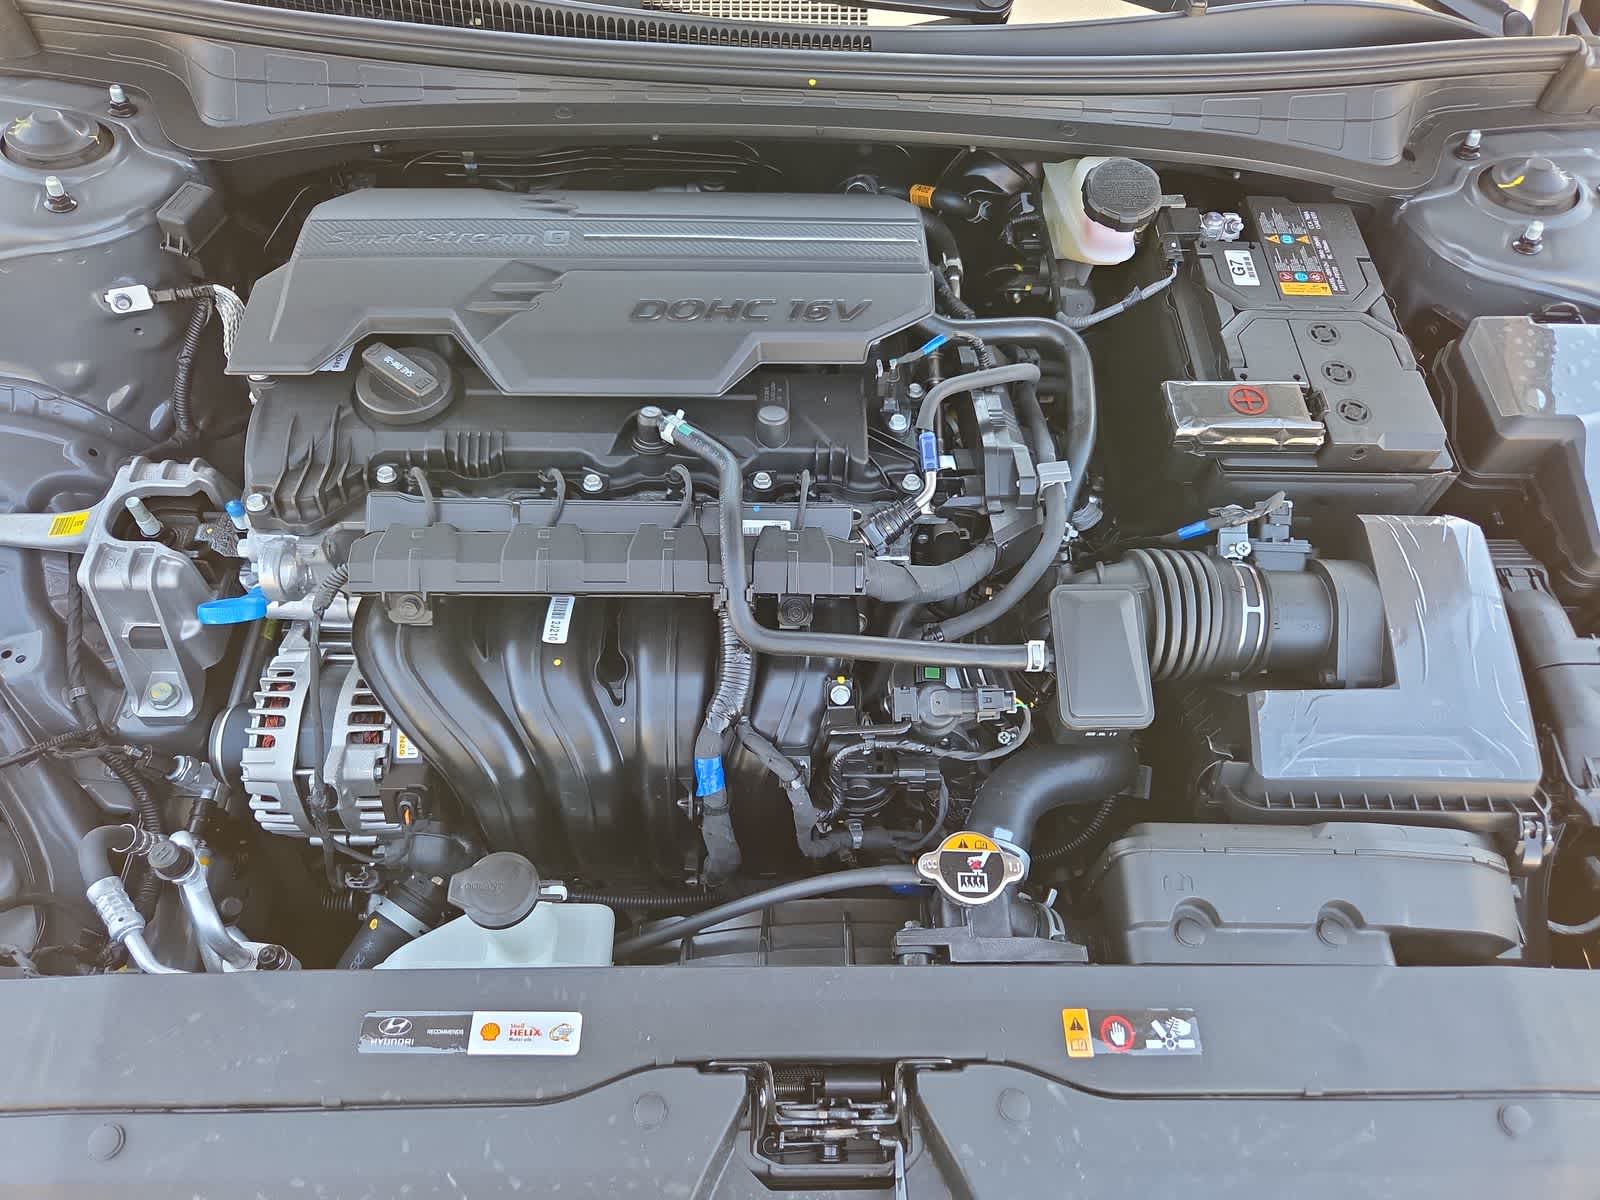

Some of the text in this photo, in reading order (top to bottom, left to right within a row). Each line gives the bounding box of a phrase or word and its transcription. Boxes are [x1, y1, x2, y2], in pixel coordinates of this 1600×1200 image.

[1230, 259, 1246, 276] G7
[630, 297, 873, 322] DOHC 16V
[399, 366, 415, 377] SAE
[509, 1028, 541, 1037] HELIX
[370, 1037, 415, 1047] HYUNDAI
